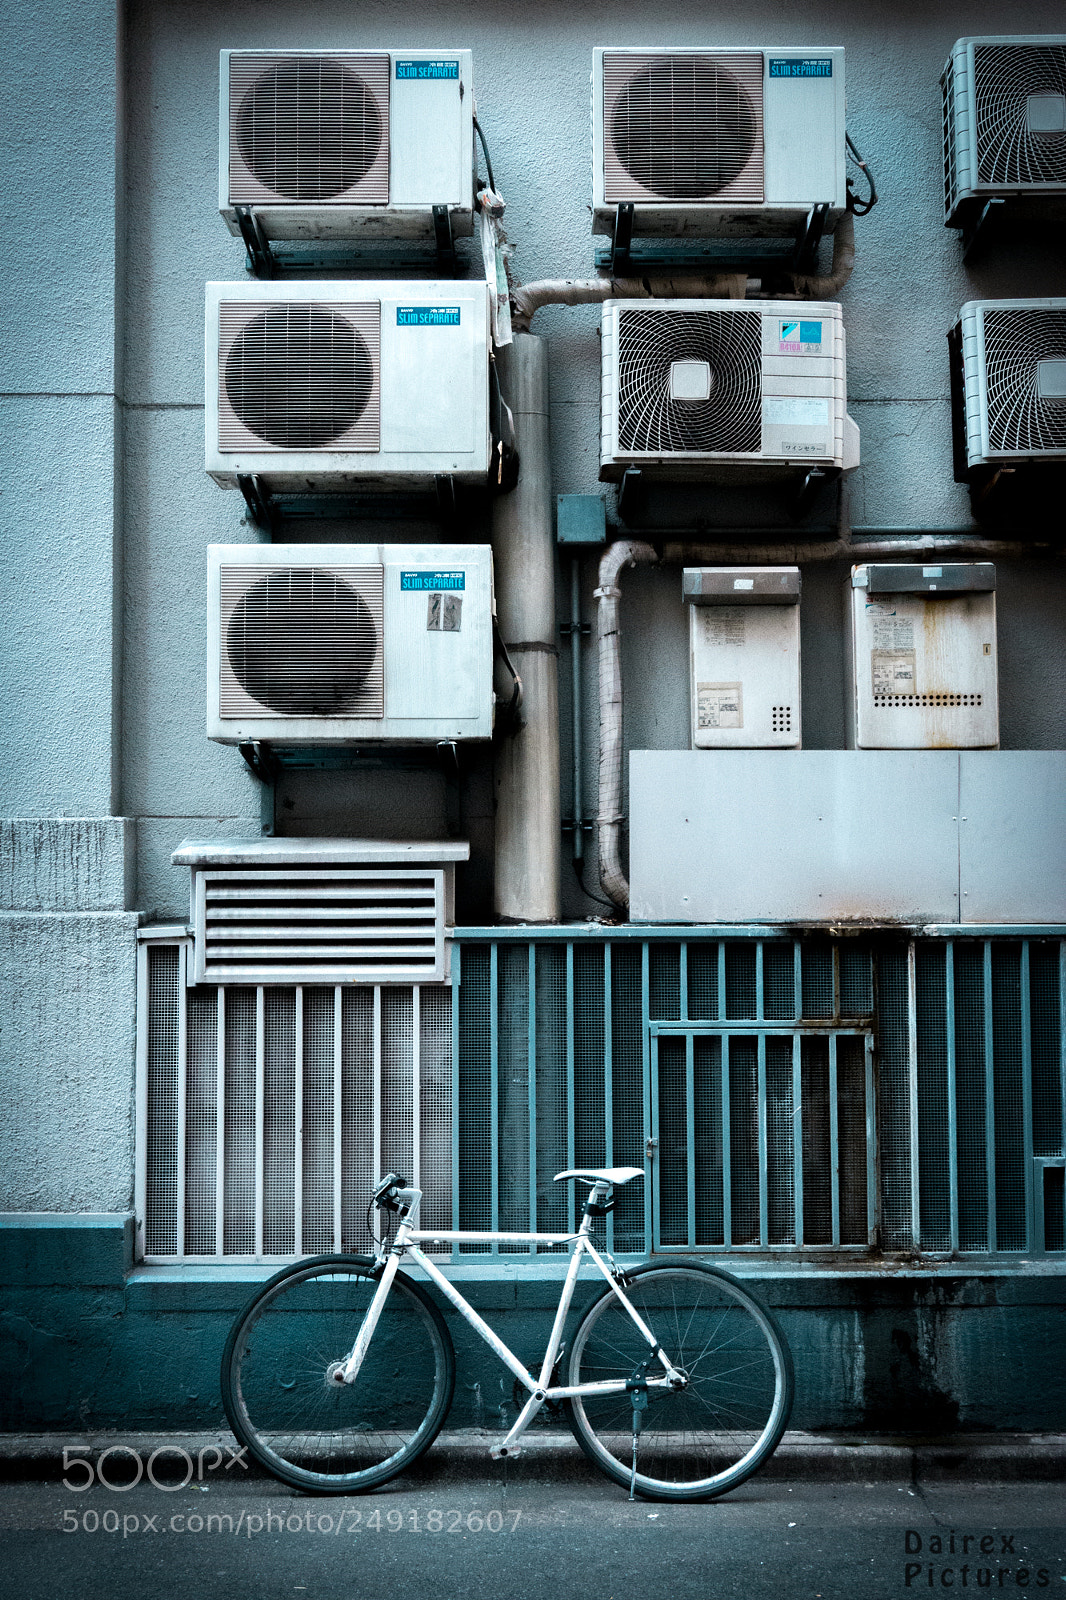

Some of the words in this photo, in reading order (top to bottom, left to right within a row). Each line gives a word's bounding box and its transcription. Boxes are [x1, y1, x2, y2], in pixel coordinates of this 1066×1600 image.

[397, 66, 418, 78] SLIM
[418, 66, 458, 78] SEPARATE
[771, 65, 791, 76] SLIM
[791, 65, 831, 76] SEPARATE
[398, 313, 419, 324] SLIM
[419, 313, 460, 324] SEPARATE
[402, 577, 423, 589] SLIM
[423, 577, 464, 589] SEPARATE
